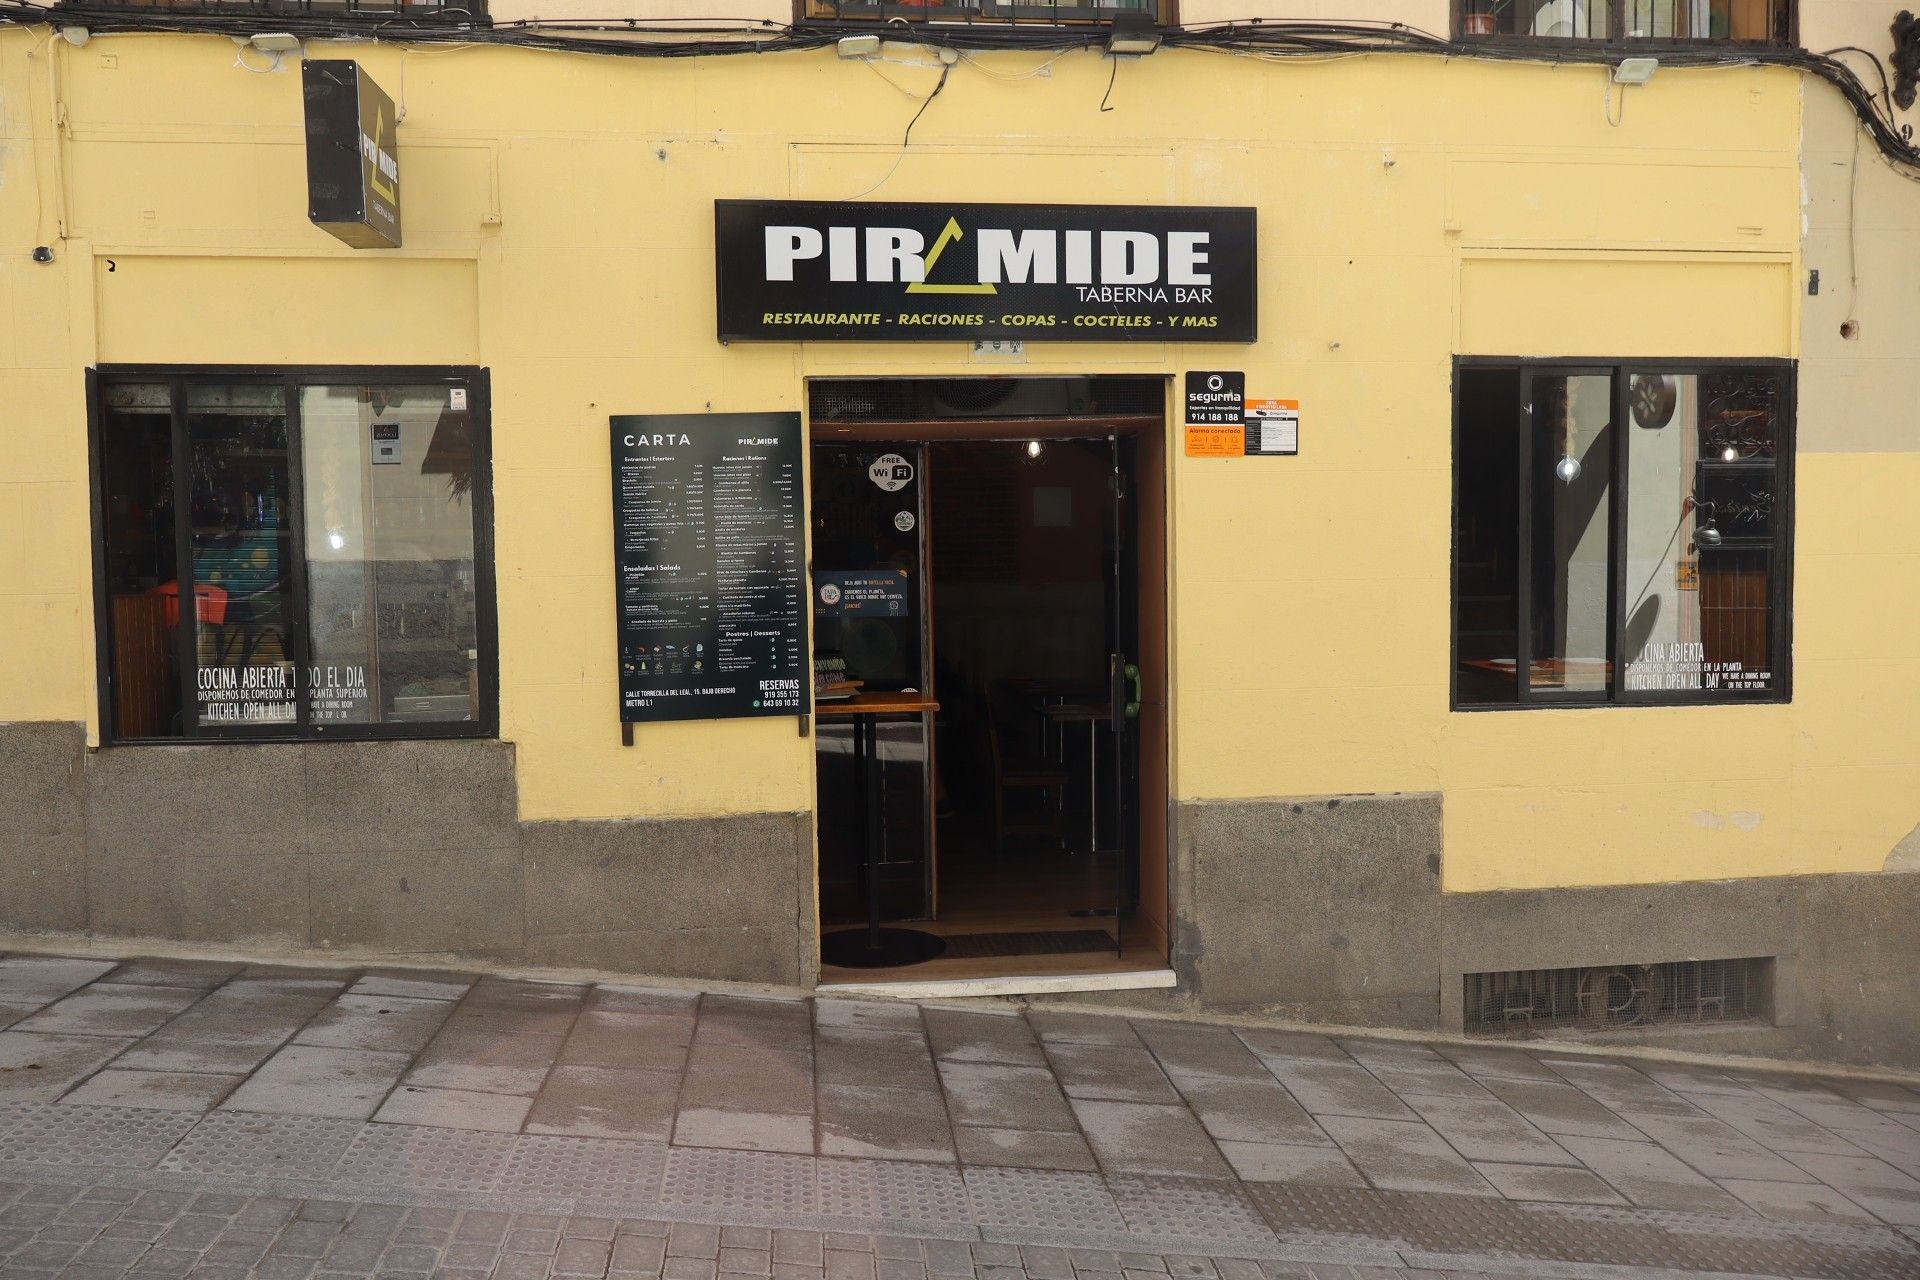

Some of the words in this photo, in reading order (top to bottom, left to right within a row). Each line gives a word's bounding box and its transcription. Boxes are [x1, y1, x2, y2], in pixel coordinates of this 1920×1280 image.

[1076, 286, 1168, 303] TABERNA
[1175, 288, 1213, 304] BAR
[762, 313, 880, 325] RESTAURANTE
[898, 314, 984, 326] RACIONES
[1001, 314, 1056, 326] COPAS
[1073, 315, 1152, 327] COCTELES
[1168, 316, 1179, 327] Y
[1182, 316, 1218, 328] MAS
[1189, 393, 1241, 404] segurma
[1192, 413, 1206, 421] 914
[1208, 413, 1222, 421] 188
[1224, 413, 1238, 421] 188
[623, 433, 691, 447] CARTA
[873, 468, 888, 476] Wi
[896, 468, 907, 476] Fi
[1668, 642, 1704, 662] ABIERTA
[1630, 663, 1663, 672] DISPONEMOS
[1666, 663, 1673, 672] DE
[1676, 663, 1701, 672] COMEDOR
[1704, 663, 1711, 671] EN
[1714, 663, 1720, 671] LA
[1722, 662, 1742, 671] PLANTA
[198, 667, 238, 690] COCINA
[242, 666, 286, 688] ABIERTA
[328, 666, 340, 688] EL
[346, 666, 365, 688] DIA
[1631, 674, 1662, 690] KITCHEN
[1666, 673, 1686, 689] OPEN
[1690, 673, 1702, 689] ALL
[1706, 673, 1720, 689] DAY
[760, 679, 800, 690] RESERVAS
[198, 690, 239, 701] DISPONEMOS
[240, 689, 250, 699] DE
[251, 689, 283, 699] COMEDOR
[286, 689, 295, 699] EN
[309, 688, 333, 699] PLANTA
[336, 688, 368, 698] SUPERIOR
[625, 690, 640, 698] CALLE
[641, 689, 670, 697] TORRECILLA
[789, 690, 800, 698] 173
[626, 699, 645, 707] METRO
[208, 702, 239, 720] KITCHEN
[243, 702, 265, 720] OPEN
[268, 702, 282, 719] ALL
[286, 702, 297, 719] DA
